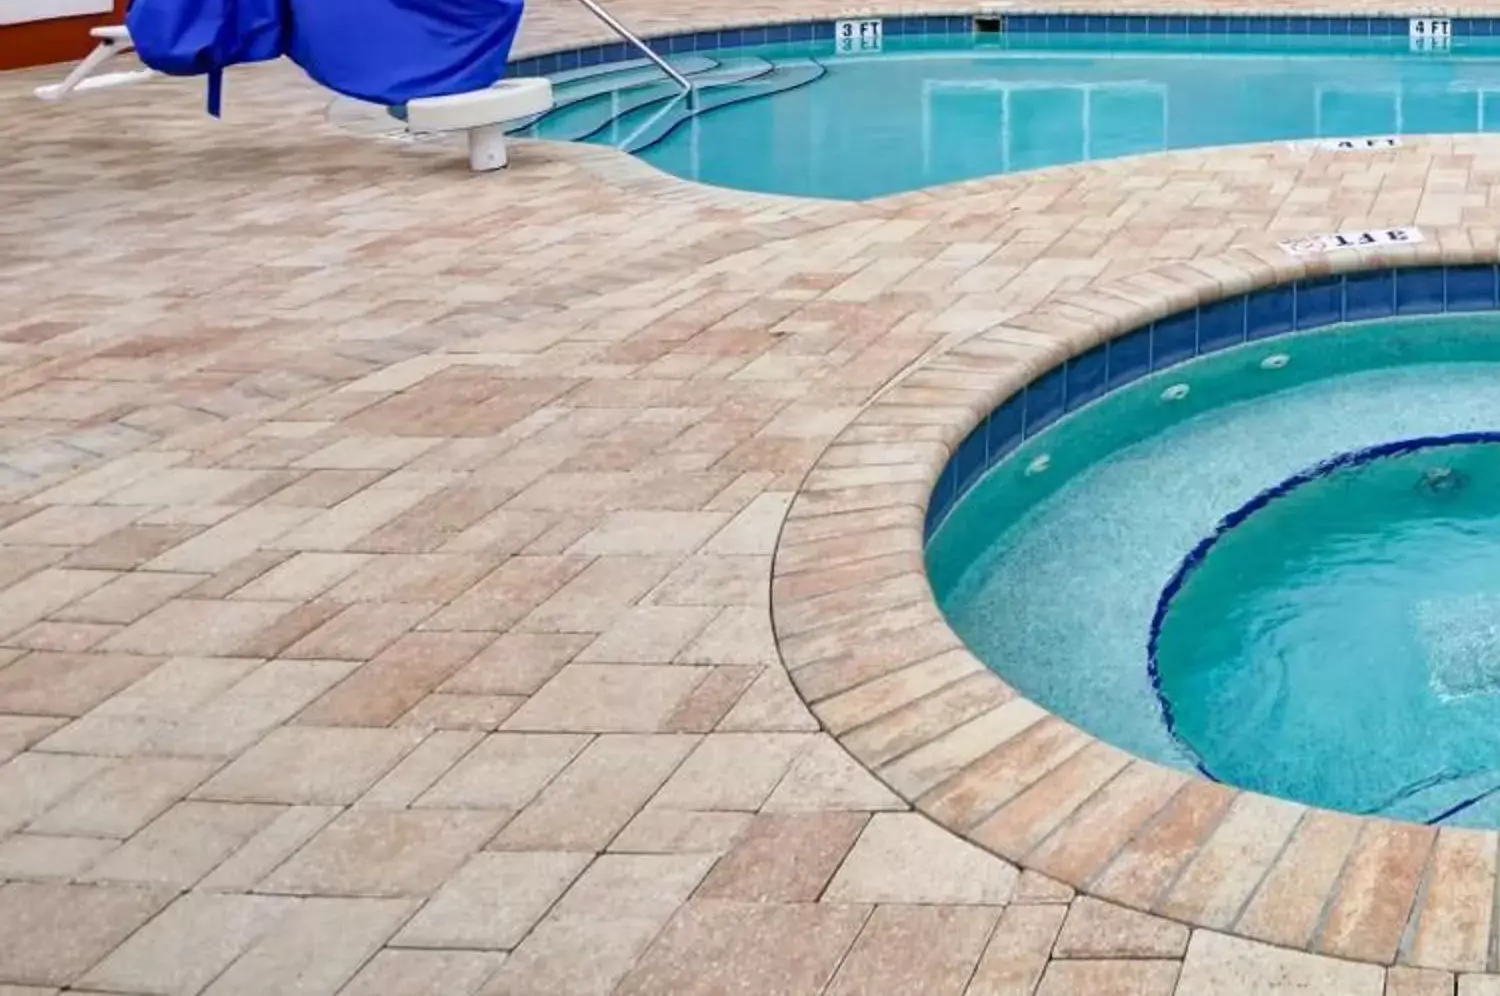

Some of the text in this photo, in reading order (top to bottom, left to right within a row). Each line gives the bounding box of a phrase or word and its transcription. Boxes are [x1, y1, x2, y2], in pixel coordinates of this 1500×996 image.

[842, 21, 881, 37] 3 FT
[1415, 20, 1449, 35] 4 FT
